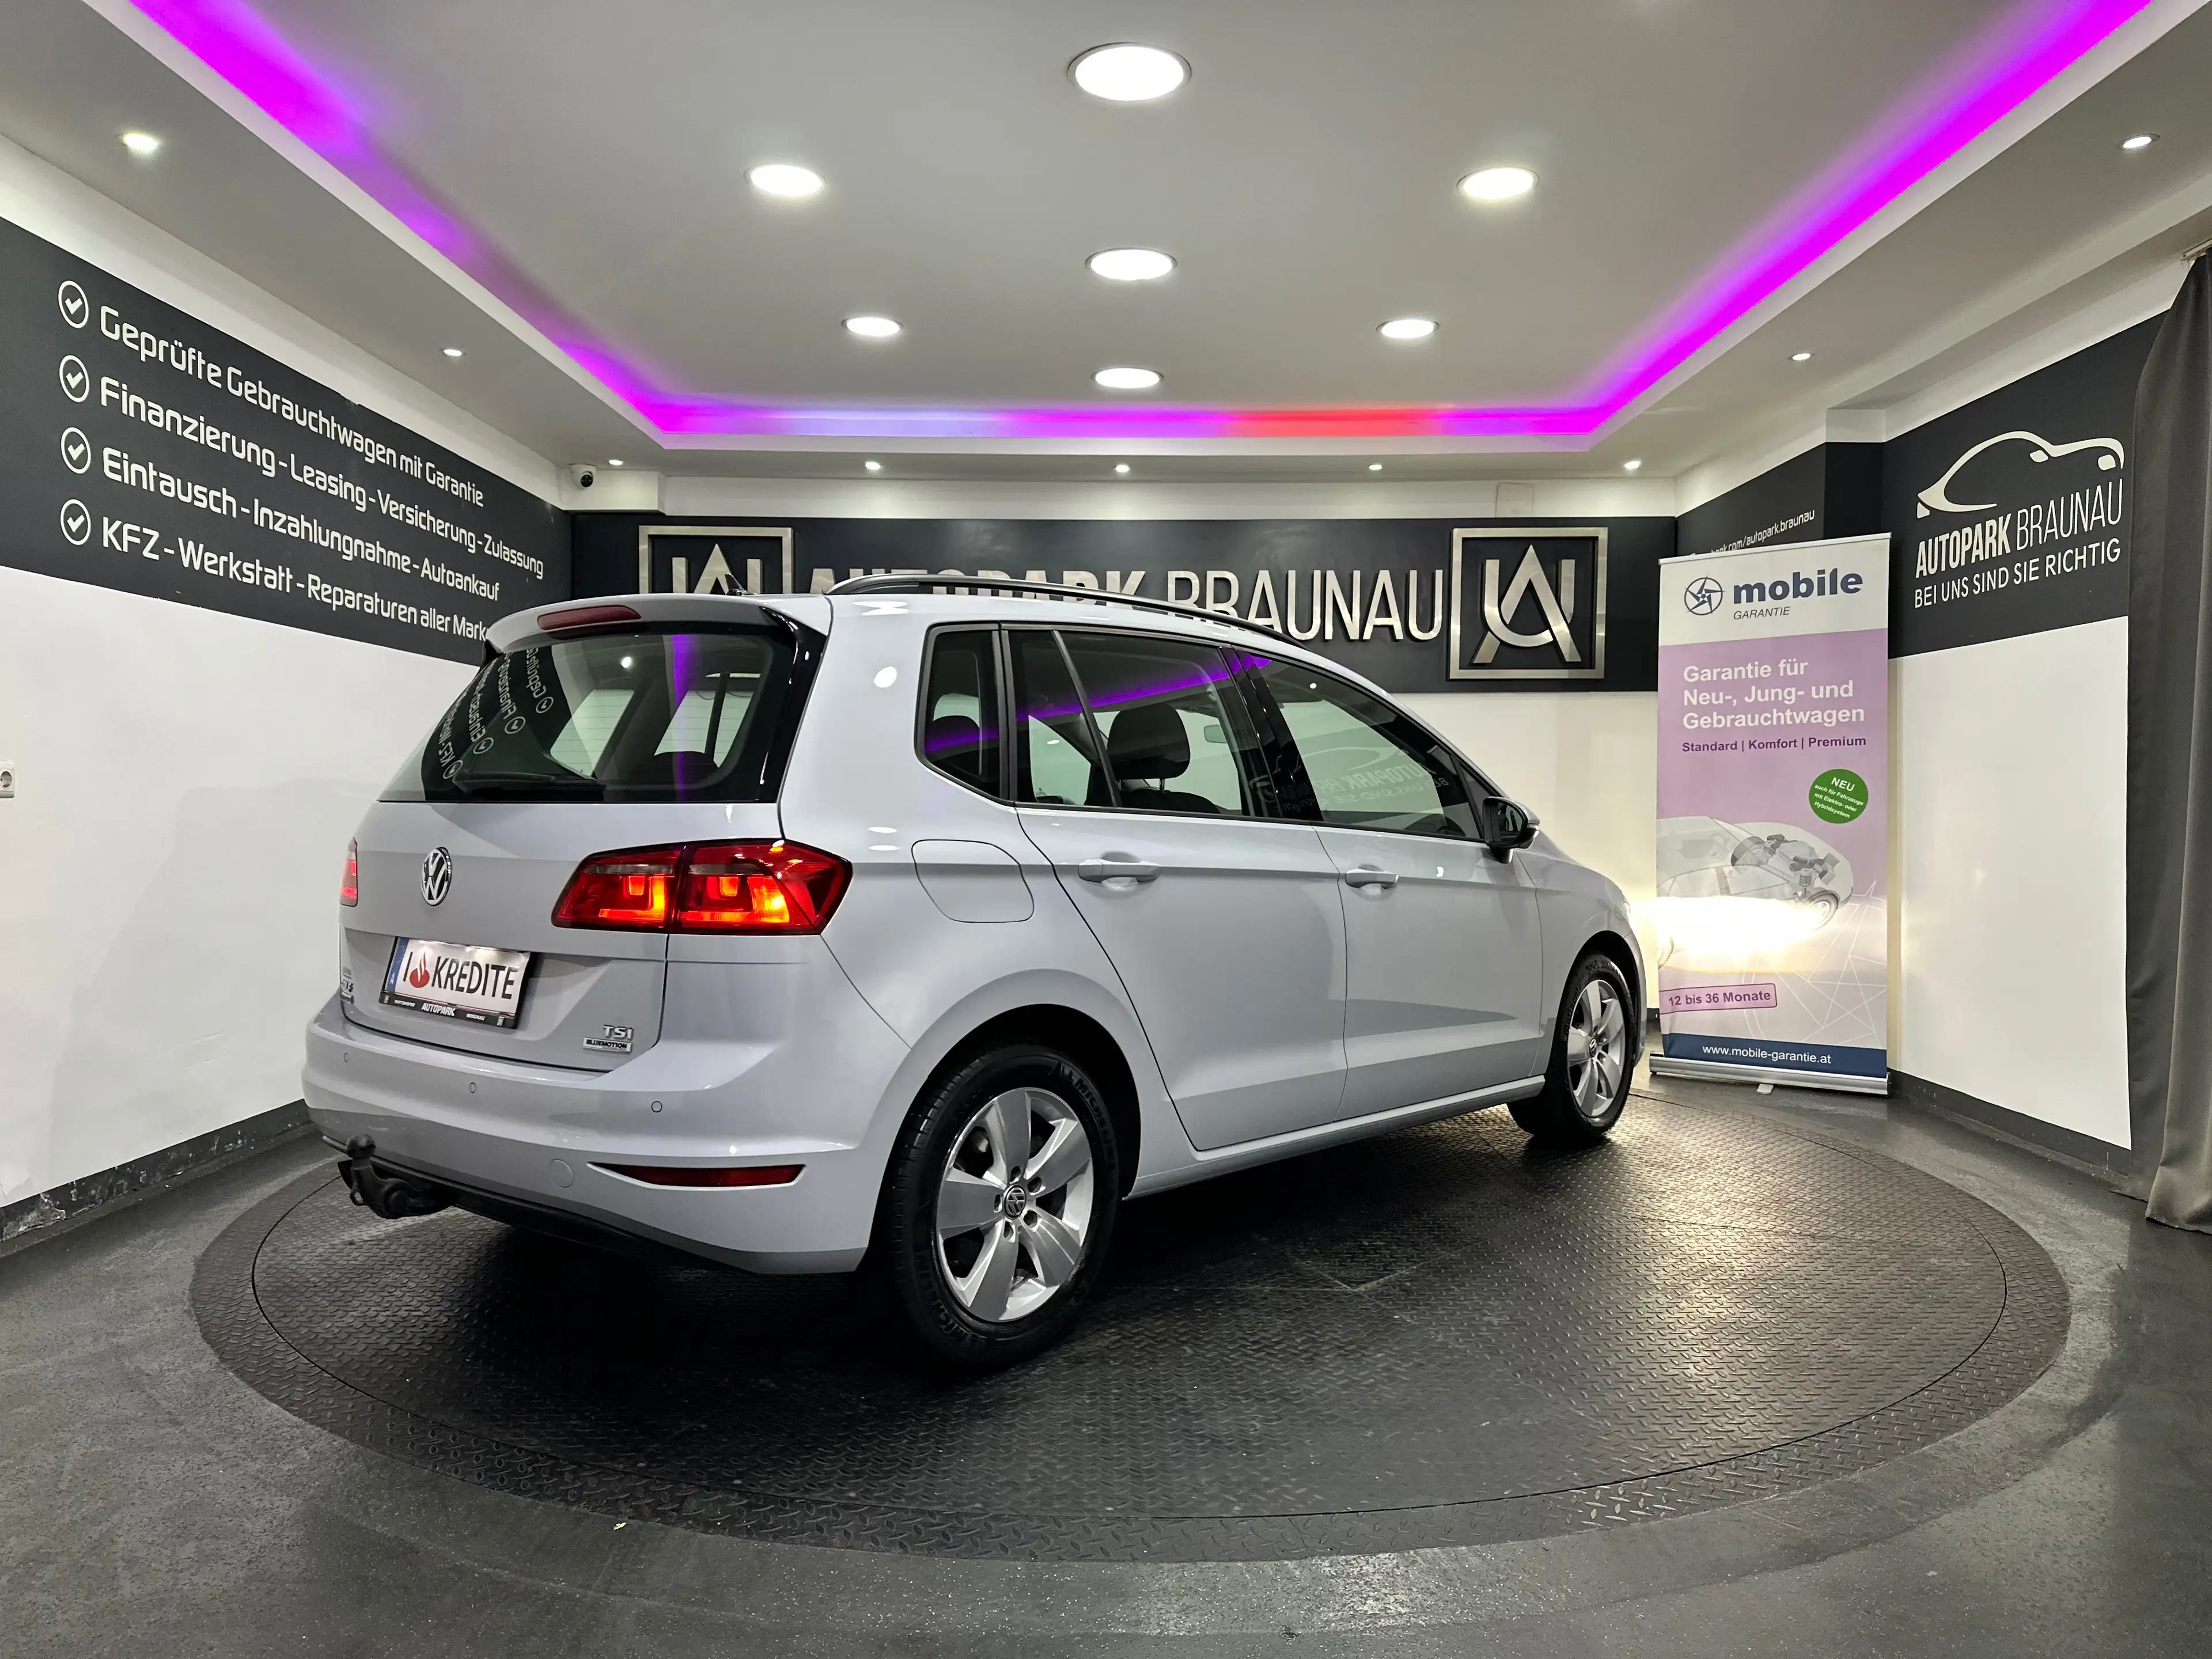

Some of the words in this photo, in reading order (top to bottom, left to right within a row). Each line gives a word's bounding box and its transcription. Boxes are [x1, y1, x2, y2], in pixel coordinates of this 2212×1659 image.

[100, 305, 222, 389] Geprüfte
[227, 366, 396, 468] Gebrauchtwagen
[399, 453, 423, 480] mit
[425, 461, 484, 507] Garantie
[1915, 513, 2012, 578] AUTOPARK
[2016, 478, 2123, 551] BRAUNAU
[103, 516, 160, 561] KFZ
[308, 573, 417, 626] Reparaturen
[420, 607, 450, 632] aller
[1914, 585, 1937, 609] BEI
[1941, 576, 1969, 603] UNS
[1972, 567, 2009, 595] SIND
[2013, 558, 2040, 585] SIE
[2045, 537, 2121, 577] RICHTIG
[1733, 567, 1863, 605] mobile
[1733, 606, 1791, 620] GARANTIE
[1683, 662, 1772, 682] Garantie
[1778, 658, 1809, 677] für
[1683, 690, 1737, 707] Neu-,
[1744, 685, 1805, 705] Jung-
[1811, 680, 1854, 698] und
[1683, 709, 1865, 730] Gebrauchtwagen
[1681, 740, 1738, 752] Standard
[1748, 738, 1798, 750] Komfort
[1808, 736, 1866, 748] Premium
[1831, 777, 1855, 791] NEU
[1814, 784, 1828, 793] auch
[1836, 791, 1864, 806] Fahrzeuge
[1814, 801, 1850, 819] Hybridsystem
[431, 955, 520, 999] KREDITE
[1669, 996, 1681, 1006] 12
[1685, 995, 1702, 1005] bis
[1705, 993, 1719, 1003] 36
[1723, 990, 1771, 1002] Monate
[421, 1002, 456, 1017] AUTOPARK
[603, 1025, 633, 1039] TSI
[586, 1039, 627, 1049] BLUEMOTION
[1702, 1045, 1832, 1064] www.mobile-garantie.at
